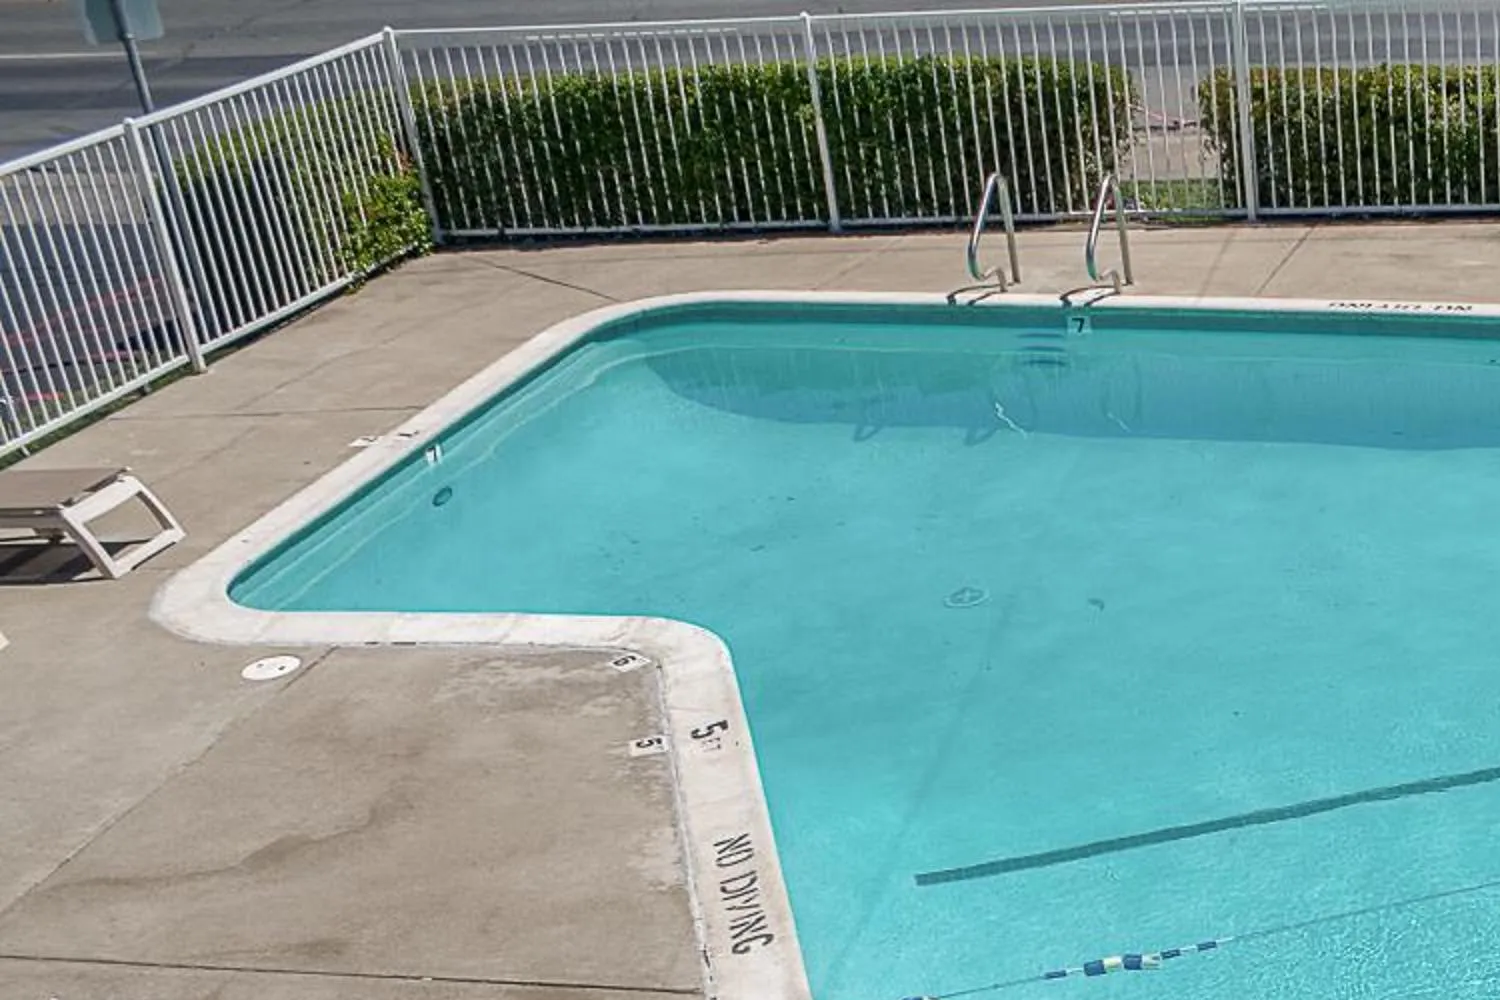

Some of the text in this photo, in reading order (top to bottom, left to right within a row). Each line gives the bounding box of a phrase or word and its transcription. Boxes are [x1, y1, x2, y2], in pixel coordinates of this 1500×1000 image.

[1071, 317, 1085, 333] 7
[689, 719, 729, 740] 5
[635, 738, 663, 750] 5
[713, 832, 775, 955] NO DIVING
